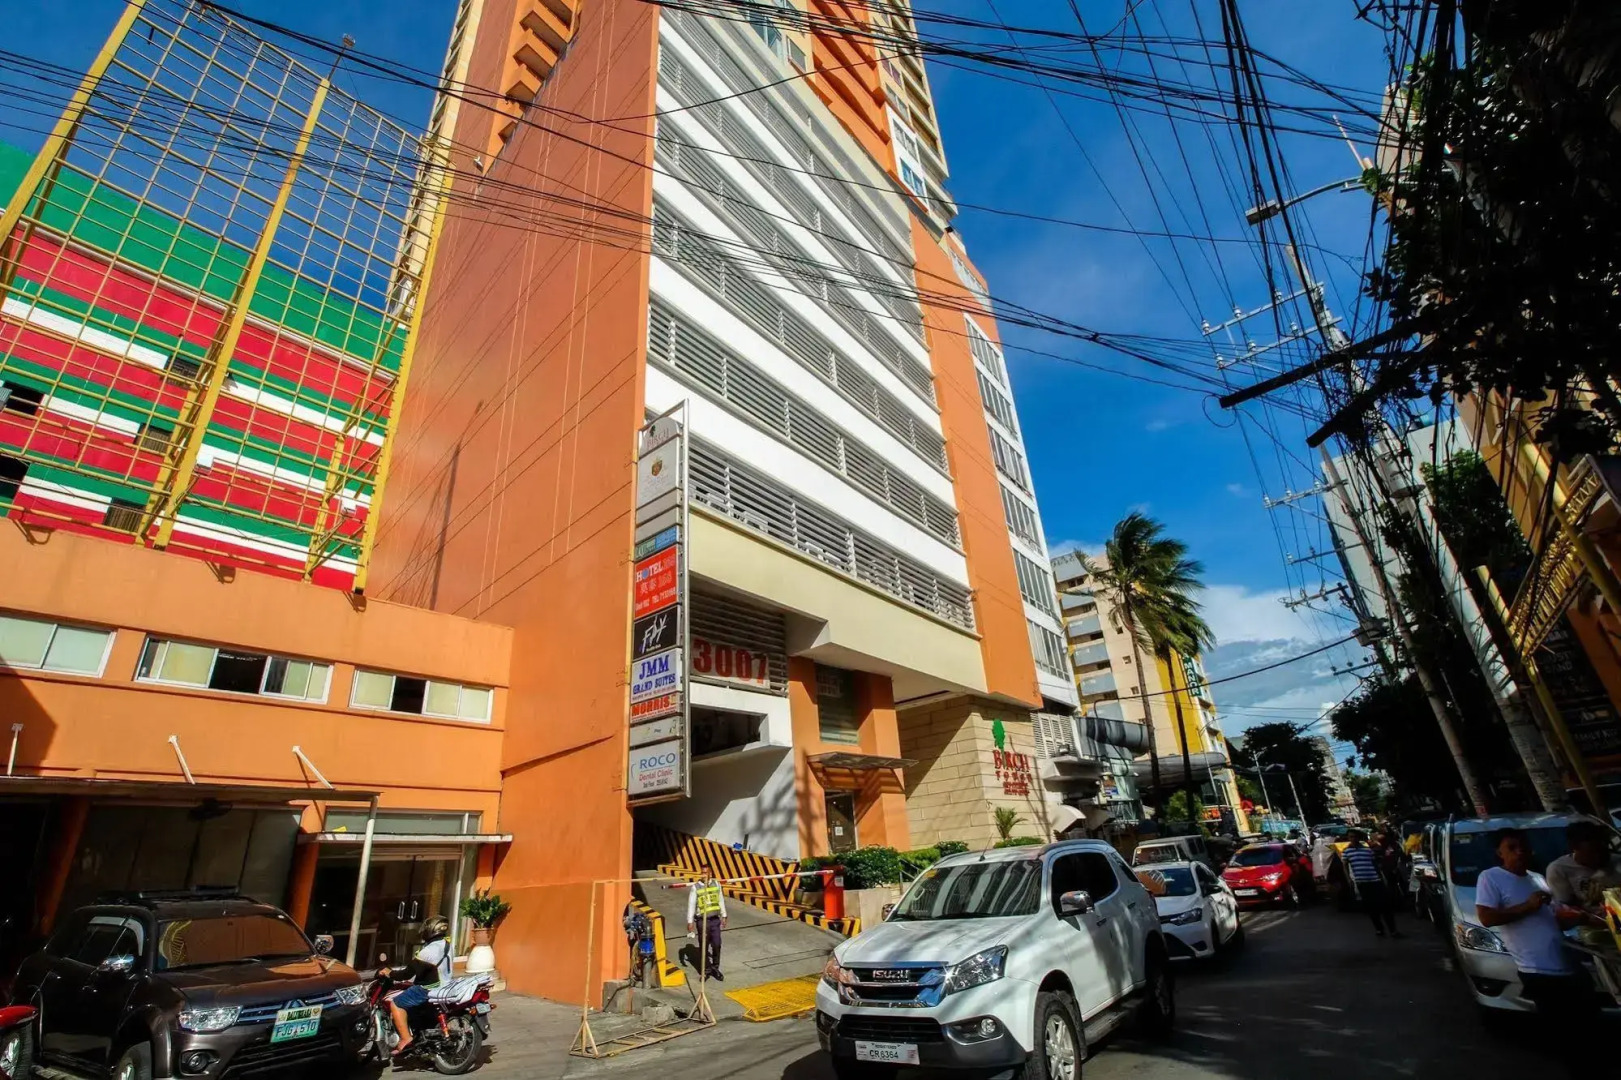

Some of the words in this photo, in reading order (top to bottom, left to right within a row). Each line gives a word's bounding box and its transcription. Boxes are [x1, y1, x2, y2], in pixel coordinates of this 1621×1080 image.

[636, 561, 664, 583] HOTEL
[639, 655, 669, 680] JMM
[693, 637, 767, 685] 3007
[633, 680, 653, 694] GRAND
[655, 673, 676, 688] SUITES
[632, 695, 670, 716] MORRIS
[639, 752, 676, 769] ROCO
[993, 750, 1030, 772] BIRCH
[639, 771, 656, 781] Dental
[657, 768, 673, 778] Clinic
[872, 969, 910, 979] ISUZU
